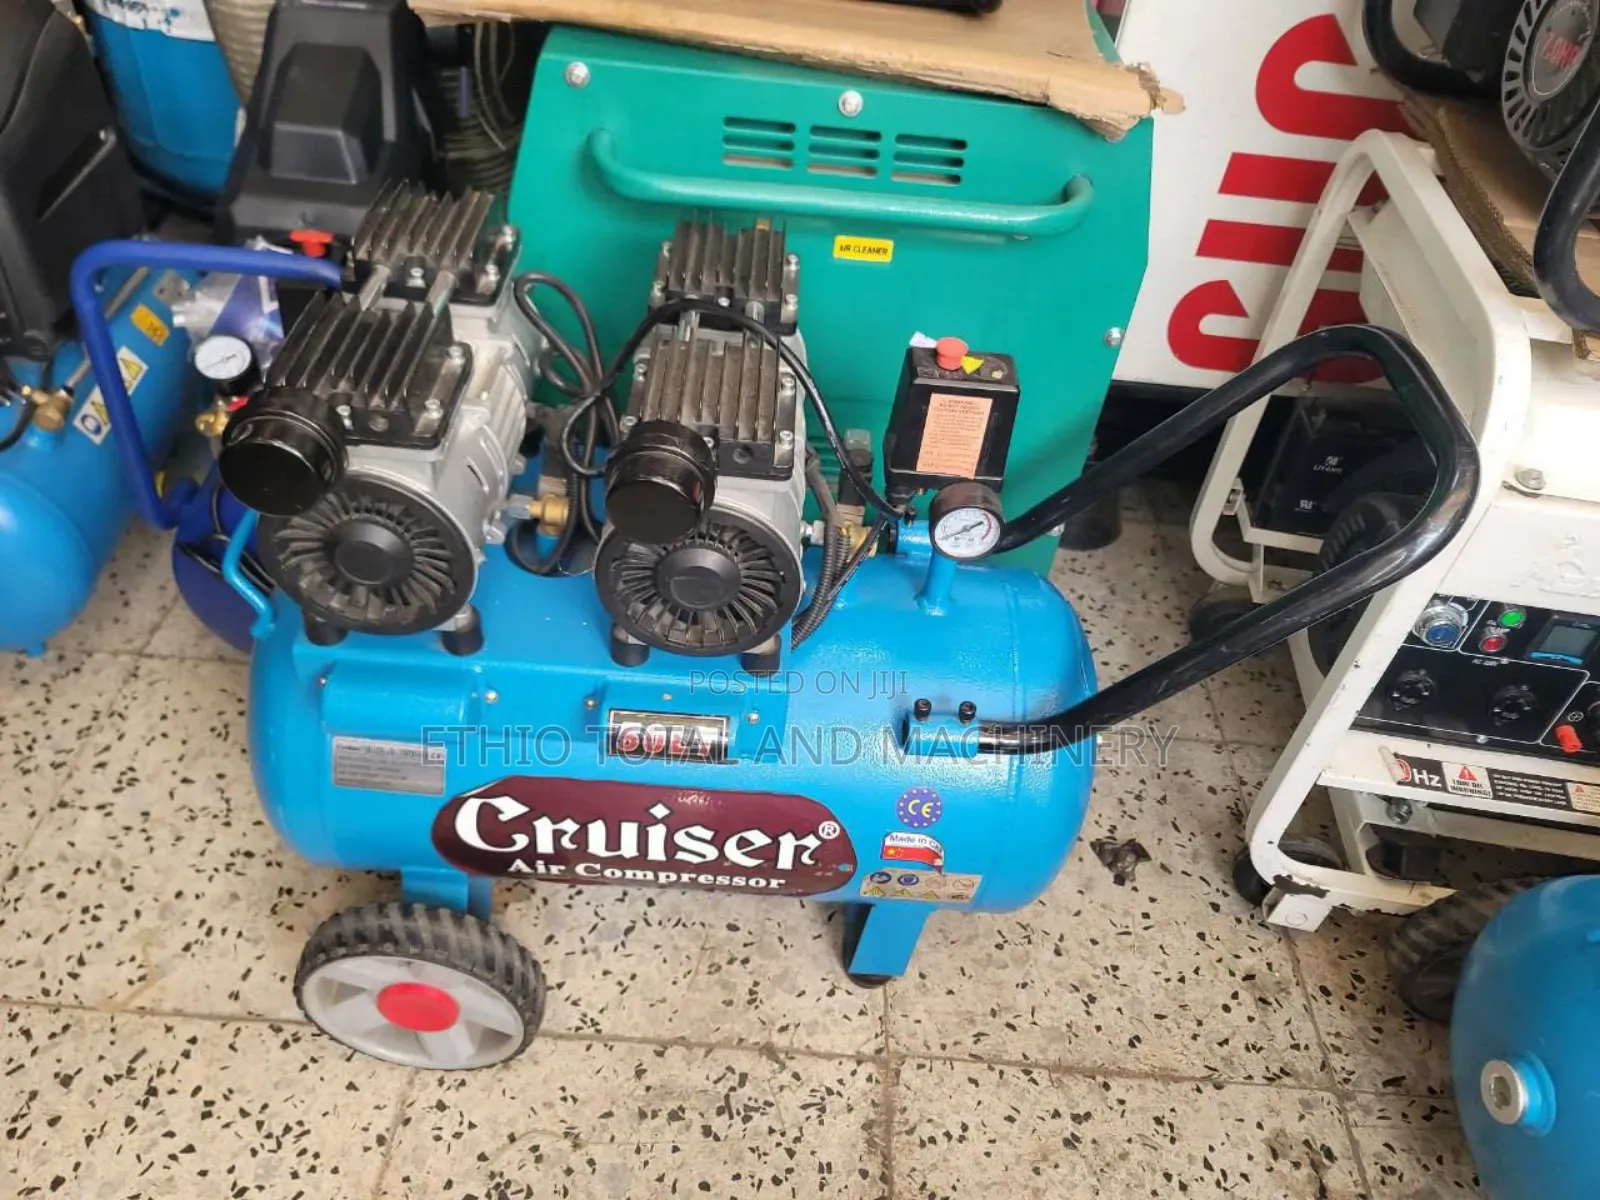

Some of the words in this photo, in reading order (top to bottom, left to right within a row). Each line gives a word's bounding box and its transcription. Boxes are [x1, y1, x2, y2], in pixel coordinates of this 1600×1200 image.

[839, 244, 851, 252] AIR
[853, 245, 889, 256] CLEANER
[455, 796, 822, 869] Cruiser
[889, 835, 916, 844] Made
[918, 837, 927, 845] in
[507, 858, 566, 875] Air
[574, 862, 786, 889] Compressor
